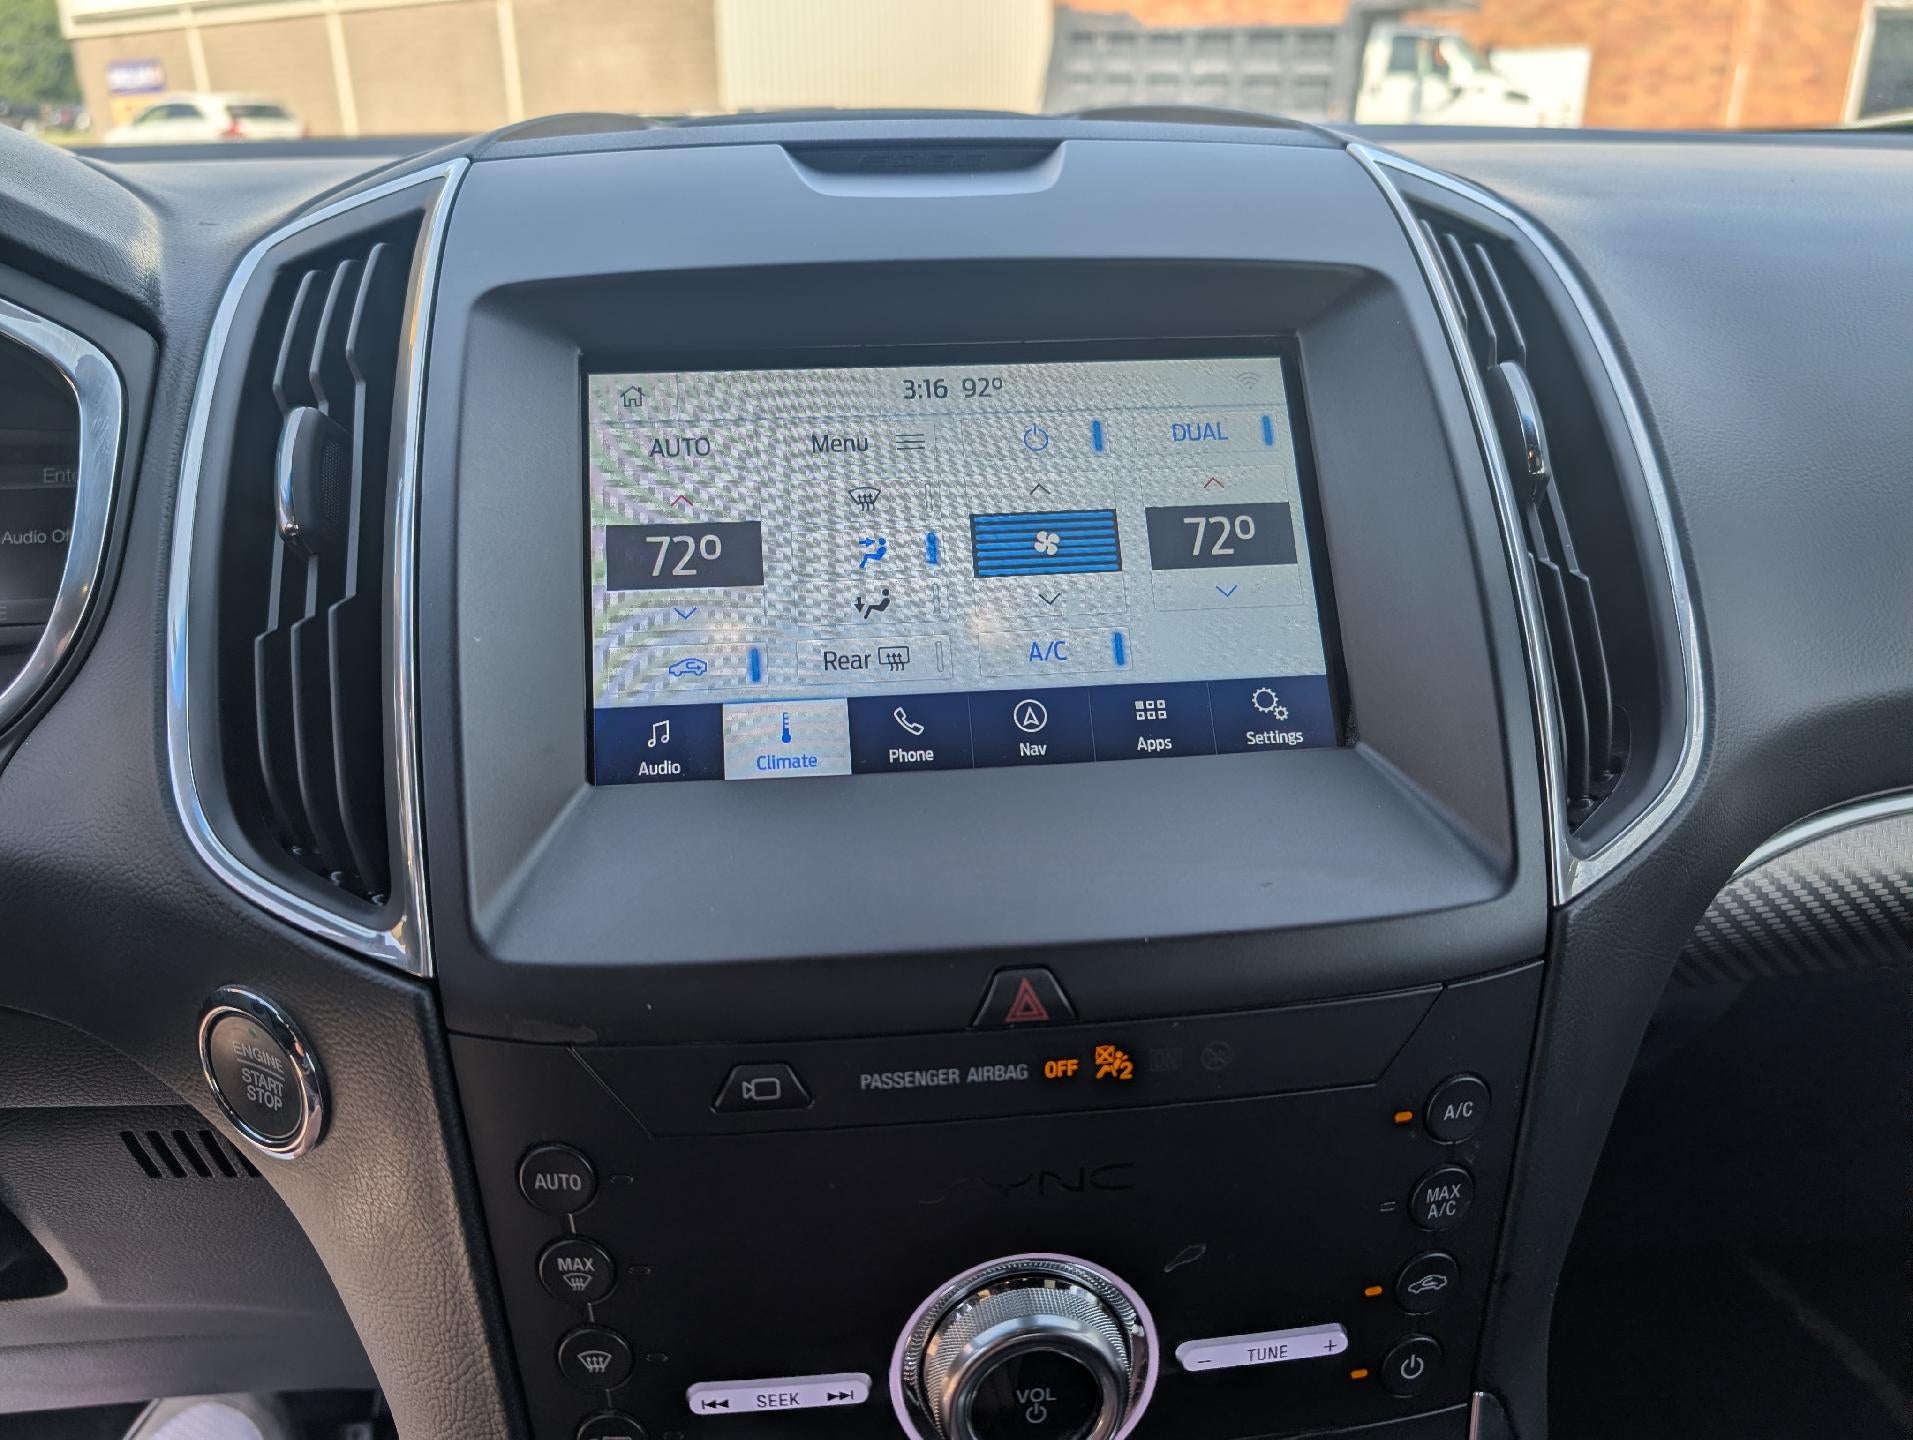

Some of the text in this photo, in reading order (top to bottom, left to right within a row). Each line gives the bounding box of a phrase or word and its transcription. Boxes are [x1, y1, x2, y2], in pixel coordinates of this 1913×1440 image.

[902, 378, 949, 400] 3:16
[1171, 421, 1229, 442] DUAL
[650, 437, 711, 459] AUTO
[811, 433, 869, 453] Menu
[1, 529, 47, 544] Audio
[1029, 640, 1068, 661] A/C
[823, 650, 872, 671] Rear
[1137, 736, 1173, 752] Apps
[1246, 730, 1304, 746] Settings
[889, 747, 935, 763] Phone
[1019, 742, 1047, 756] Nav
[638, 760, 681, 776] Audio
[756, 753, 818, 771] Climate
[232, 1041, 285, 1074] ENGINE
[241, 1067, 284, 1097] START
[859, 1058, 1079, 1091] PASSENGER AIRBAG OFF
[247, 1083, 283, 1111] STOP
[1443, 1101, 1474, 1120] A/C
[534, 1173, 582, 1191] AUTO
[1426, 1183, 1462, 1204] MAX
[1427, 1200, 1457, 1220] A/C
[557, 1257, 596, 1273] MAX
[1247, 1345, 1289, 1363] TUNE
[756, 1392, 800, 1409] SEEK
[1016, 1387, 1057, 1404] VOL
